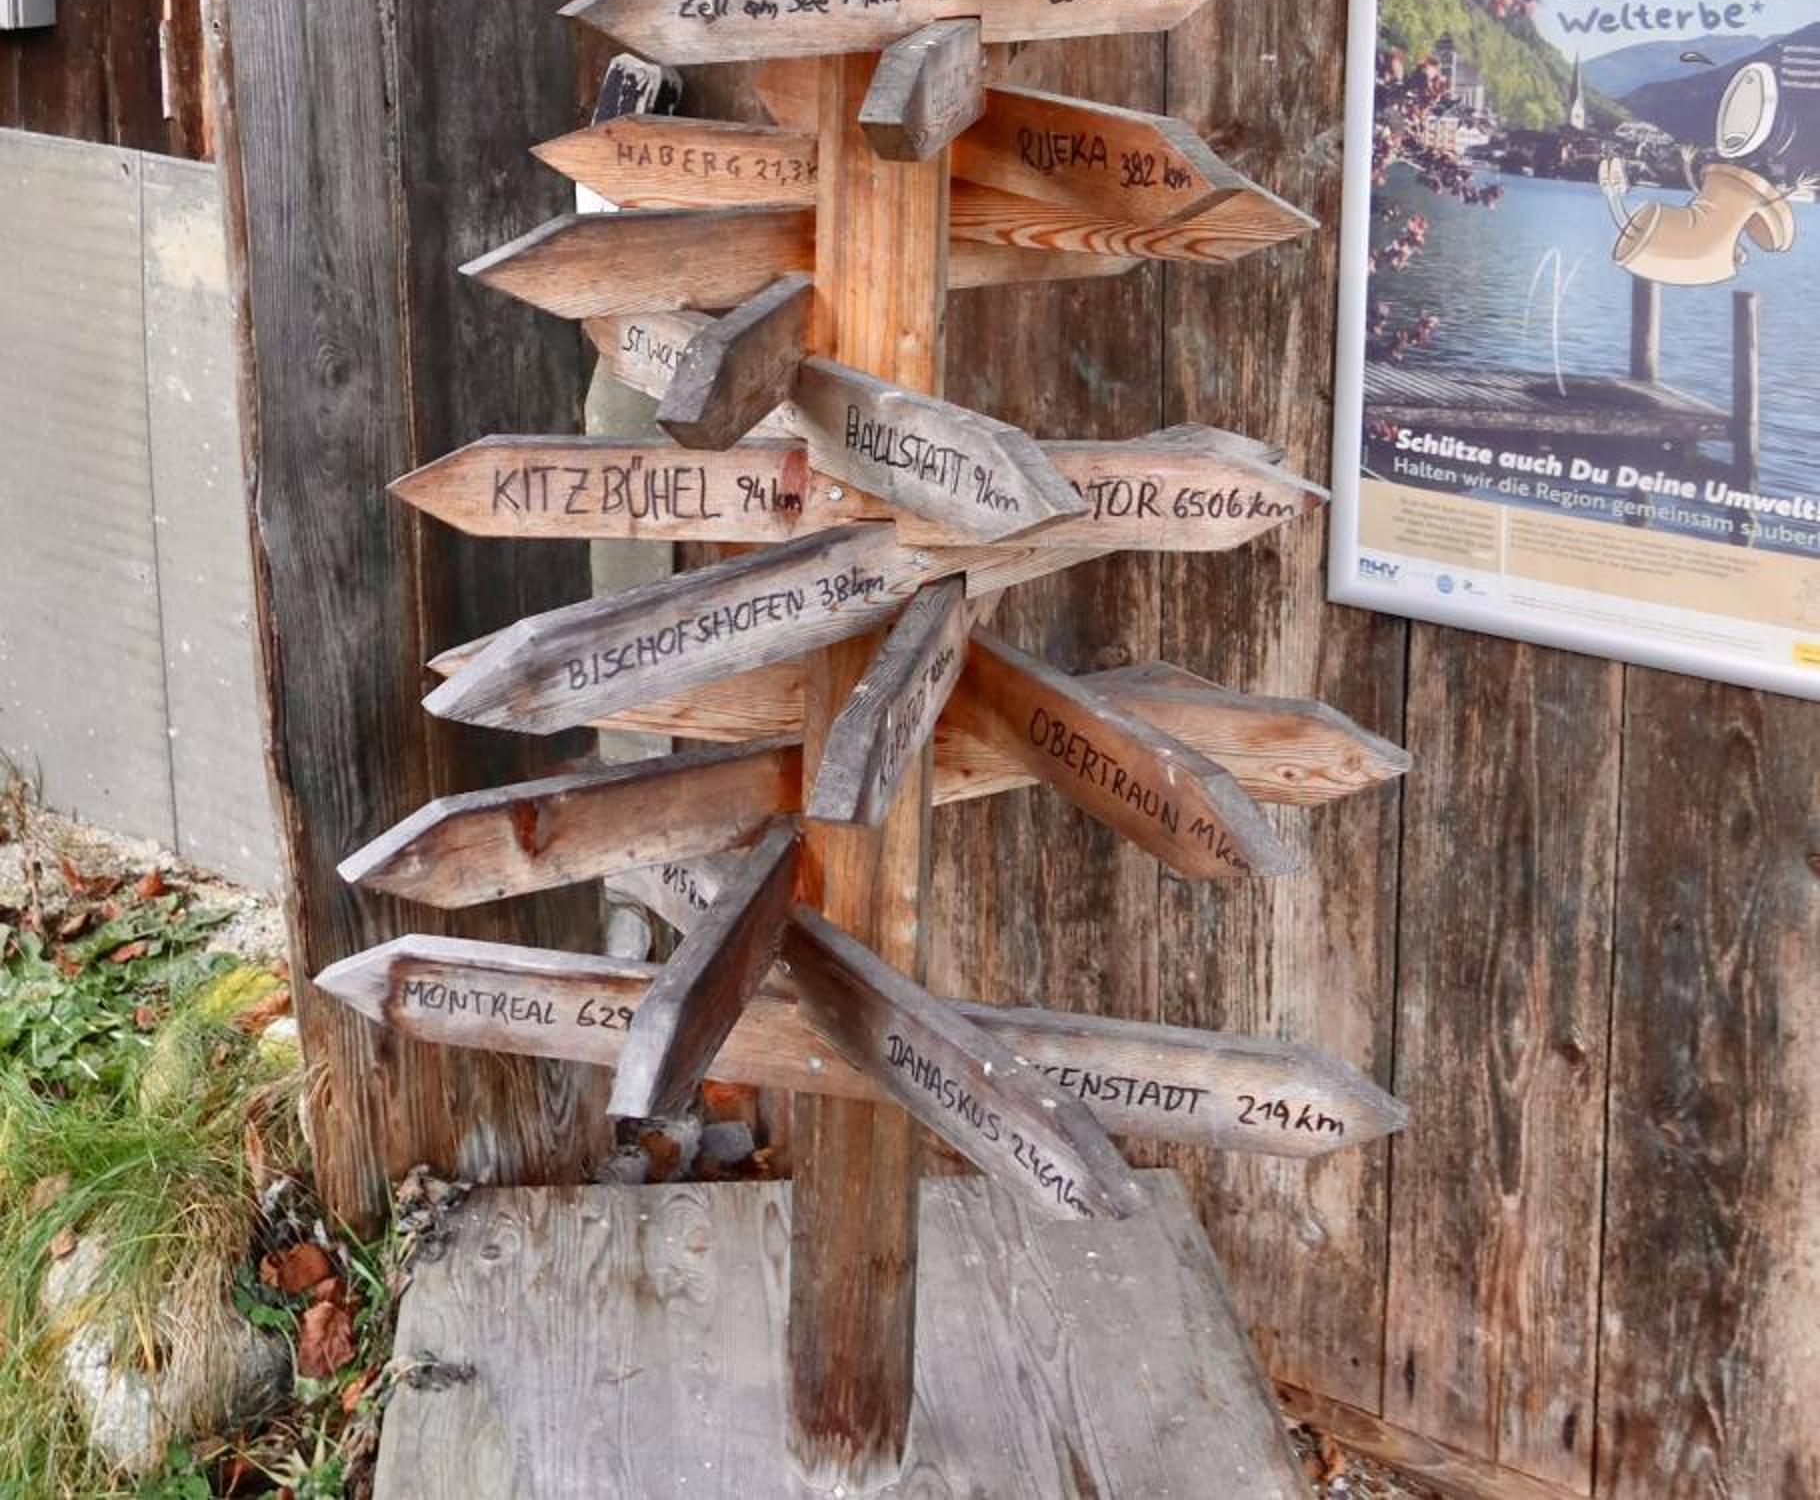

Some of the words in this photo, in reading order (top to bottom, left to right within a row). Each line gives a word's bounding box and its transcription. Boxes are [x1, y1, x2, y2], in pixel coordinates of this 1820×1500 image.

[743, 0, 779, 20] am
[1016, 126, 1108, 175] RIJEKA
[845, 404, 969, 495] HALLSTATT
[1395, 430, 1493, 465] Schütze
[1499, 451, 1563, 478] auch
[1569, 458, 1609, 485] Du
[1616, 465, 1697, 499] Deine
[1393, 457, 1457, 483] Halten
[1463, 472, 1494, 489] wir
[1500, 476, 1530, 497] die
[1536, 482, 1606, 510] Region
[1612, 498, 1734, 533] gemeinsam
[564, 589, 805, 690] BISCHOFSHOFEN
[1029, 707, 1180, 834] OBERTRAUN
[400, 979, 557, 1025] MONTREAL
[888, 1034, 1002, 1142] DAMASKUS
